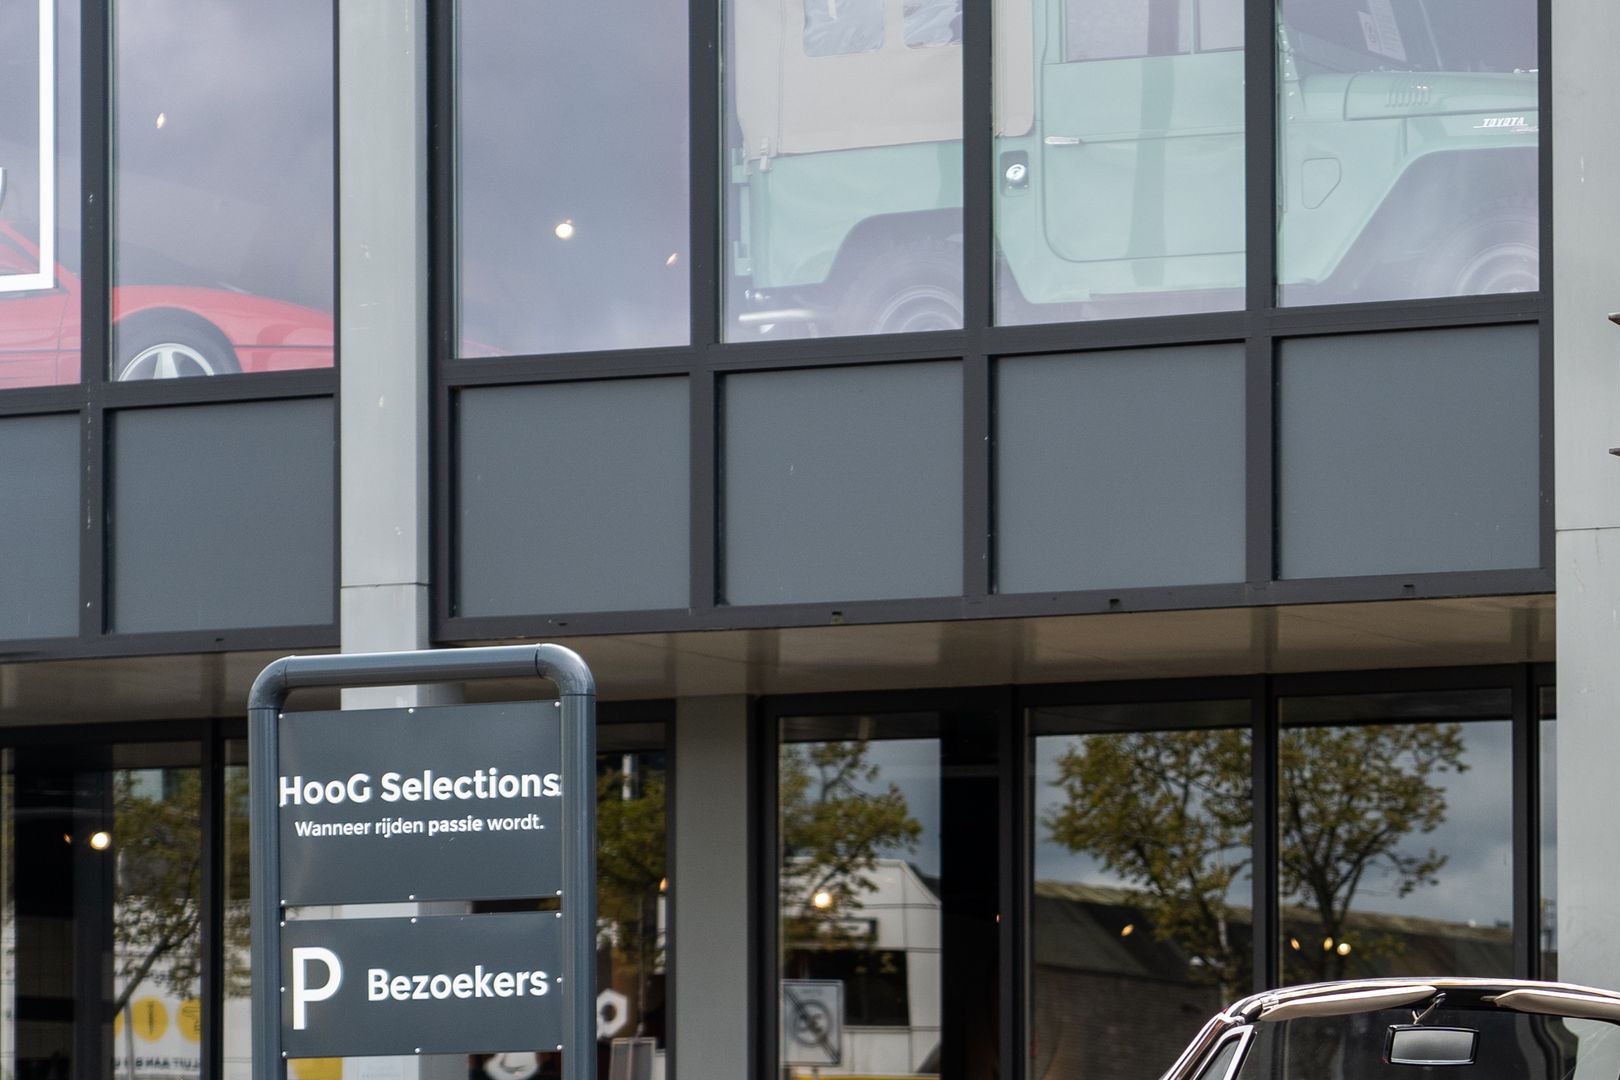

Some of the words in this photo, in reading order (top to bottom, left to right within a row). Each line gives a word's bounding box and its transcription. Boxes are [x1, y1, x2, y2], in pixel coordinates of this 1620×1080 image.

[1482, 117, 1525, 127] TOYOTA
[279, 772, 371, 805] HooG
[380, 767, 562, 802] Selections
[294, 820, 371, 837] Wanneer
[375, 816, 424, 839] rijden
[428, 814, 483, 837] passie
[486, 813, 545, 832] wordt.
[292, 946, 343, 1030] P
[367, 965, 550, 1002] Bezoekers
